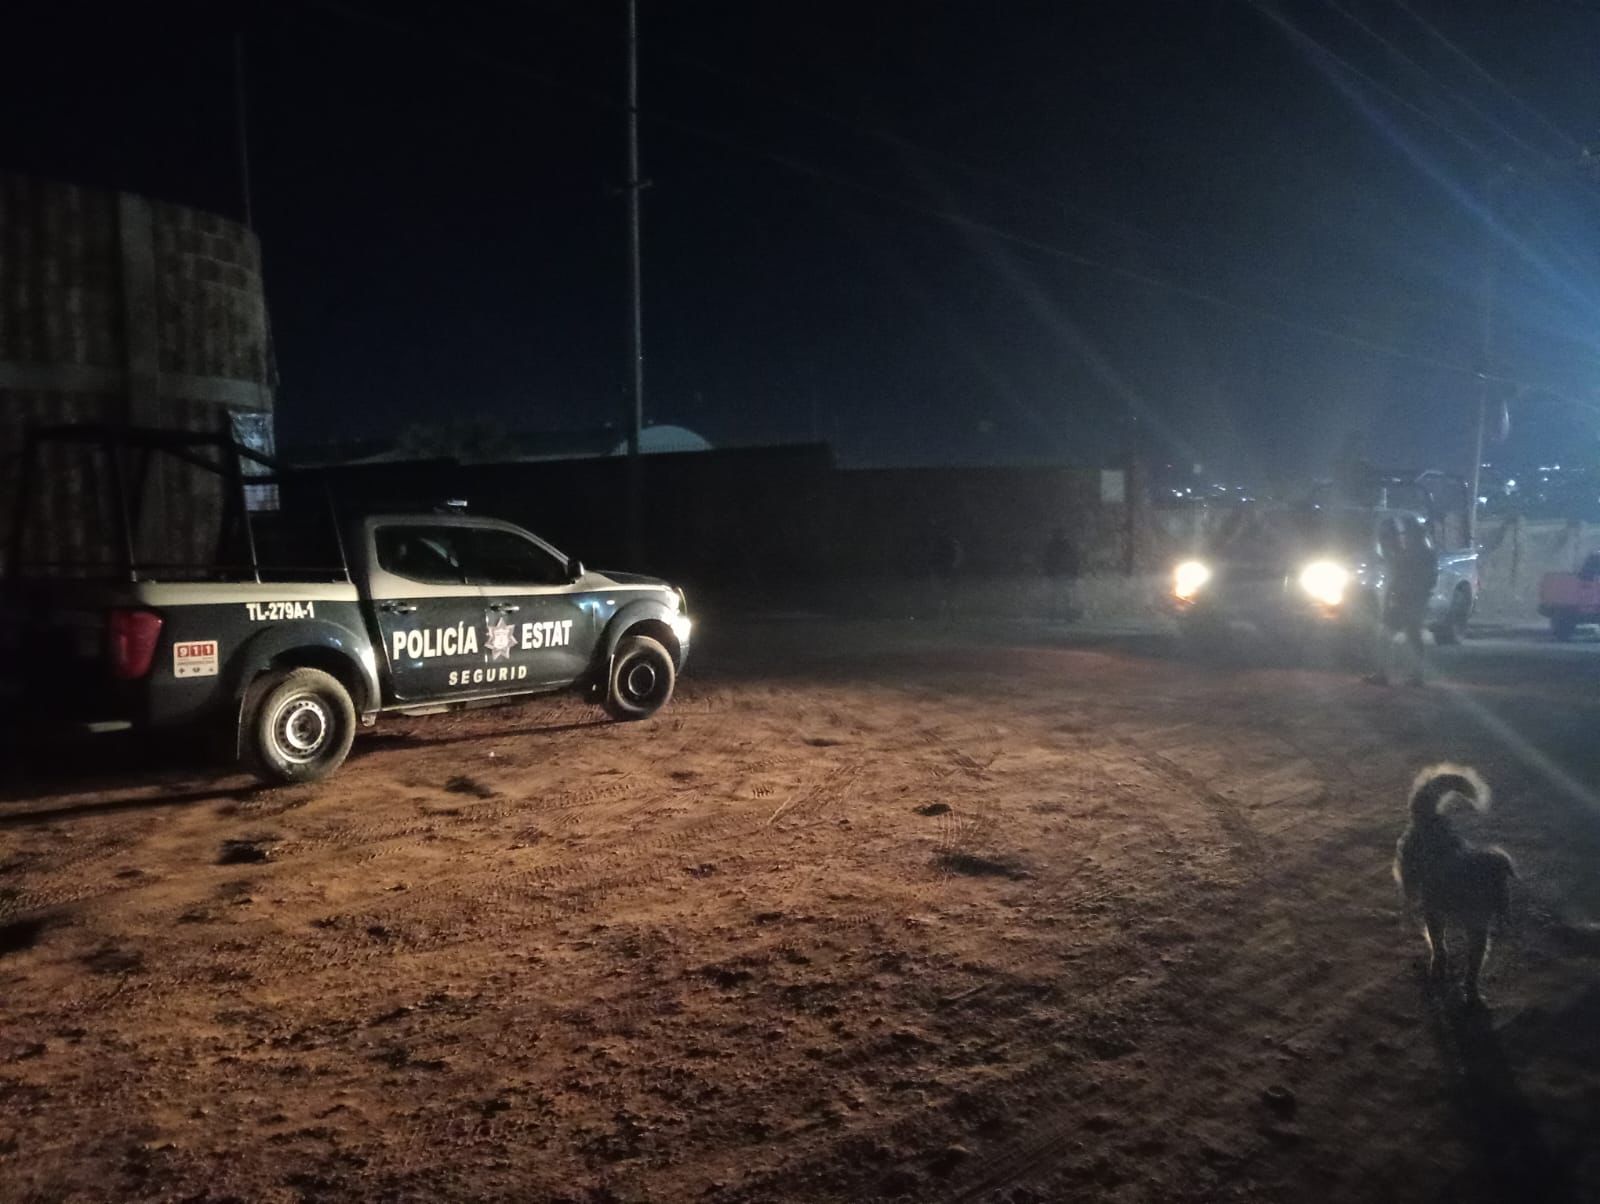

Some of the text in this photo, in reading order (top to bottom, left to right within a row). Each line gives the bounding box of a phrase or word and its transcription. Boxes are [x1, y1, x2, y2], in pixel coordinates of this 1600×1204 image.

[246, 601, 314, 621] TL-279A-1
[393, 620, 572, 659] POLICÍA ESTAT
[178, 645, 213, 657] 911
[449, 666, 527, 685] SEGURID
